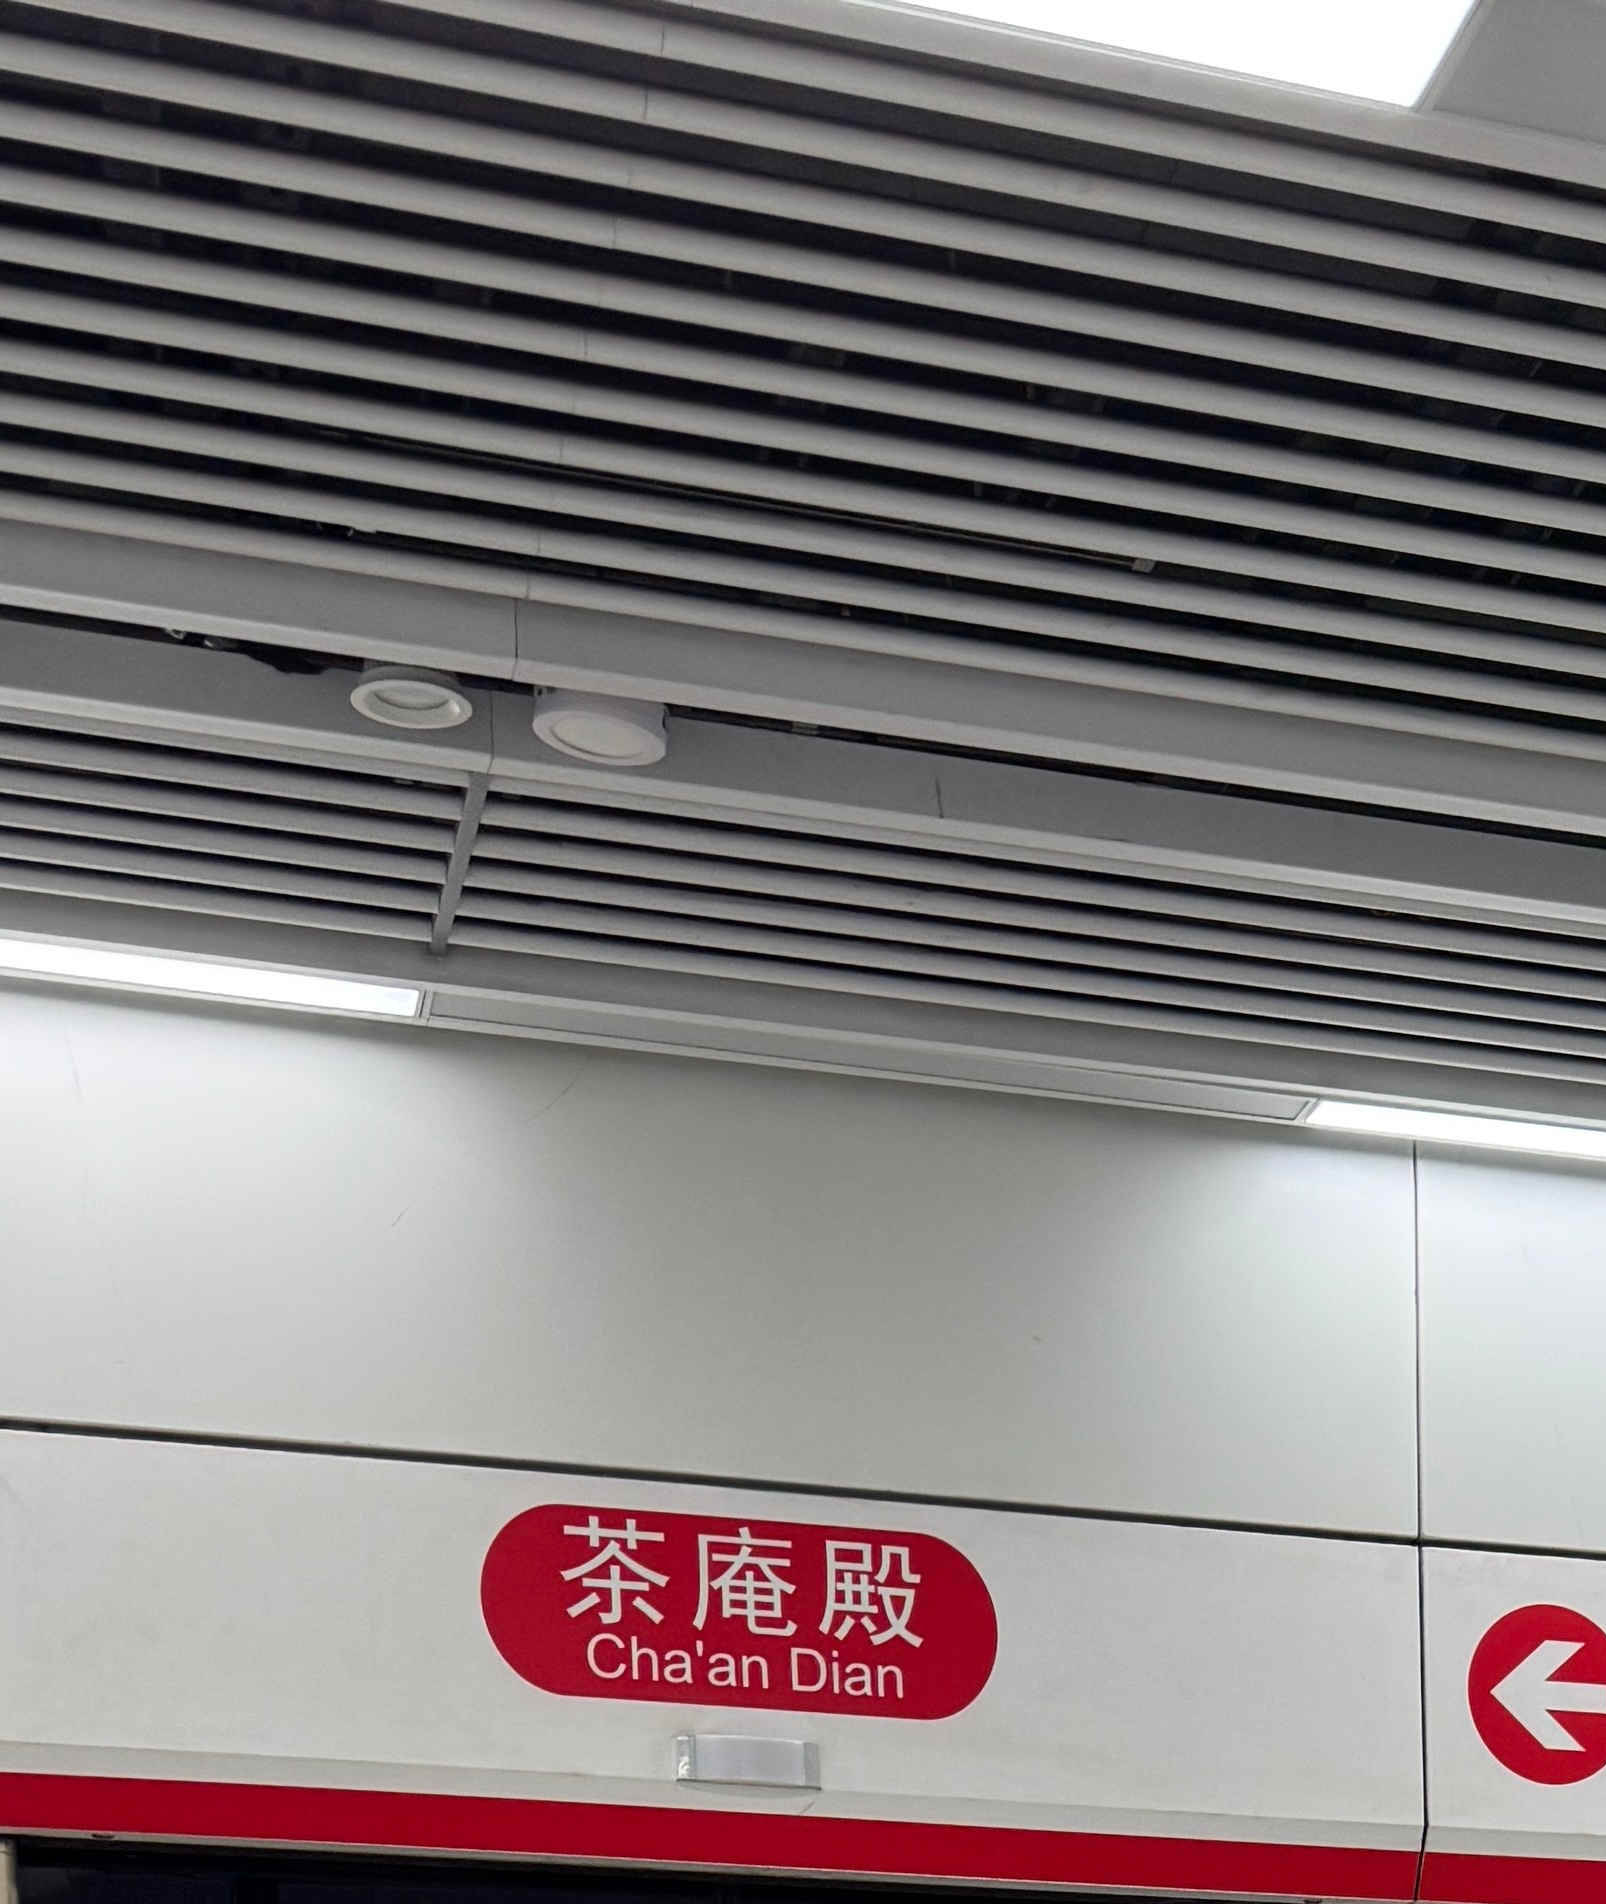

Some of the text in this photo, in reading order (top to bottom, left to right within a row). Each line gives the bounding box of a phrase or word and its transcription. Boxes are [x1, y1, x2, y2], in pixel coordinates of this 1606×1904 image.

[560, 1515, 923, 1648] 茶庵殿
[587, 1633, 904, 1699] Cha'an Dian
